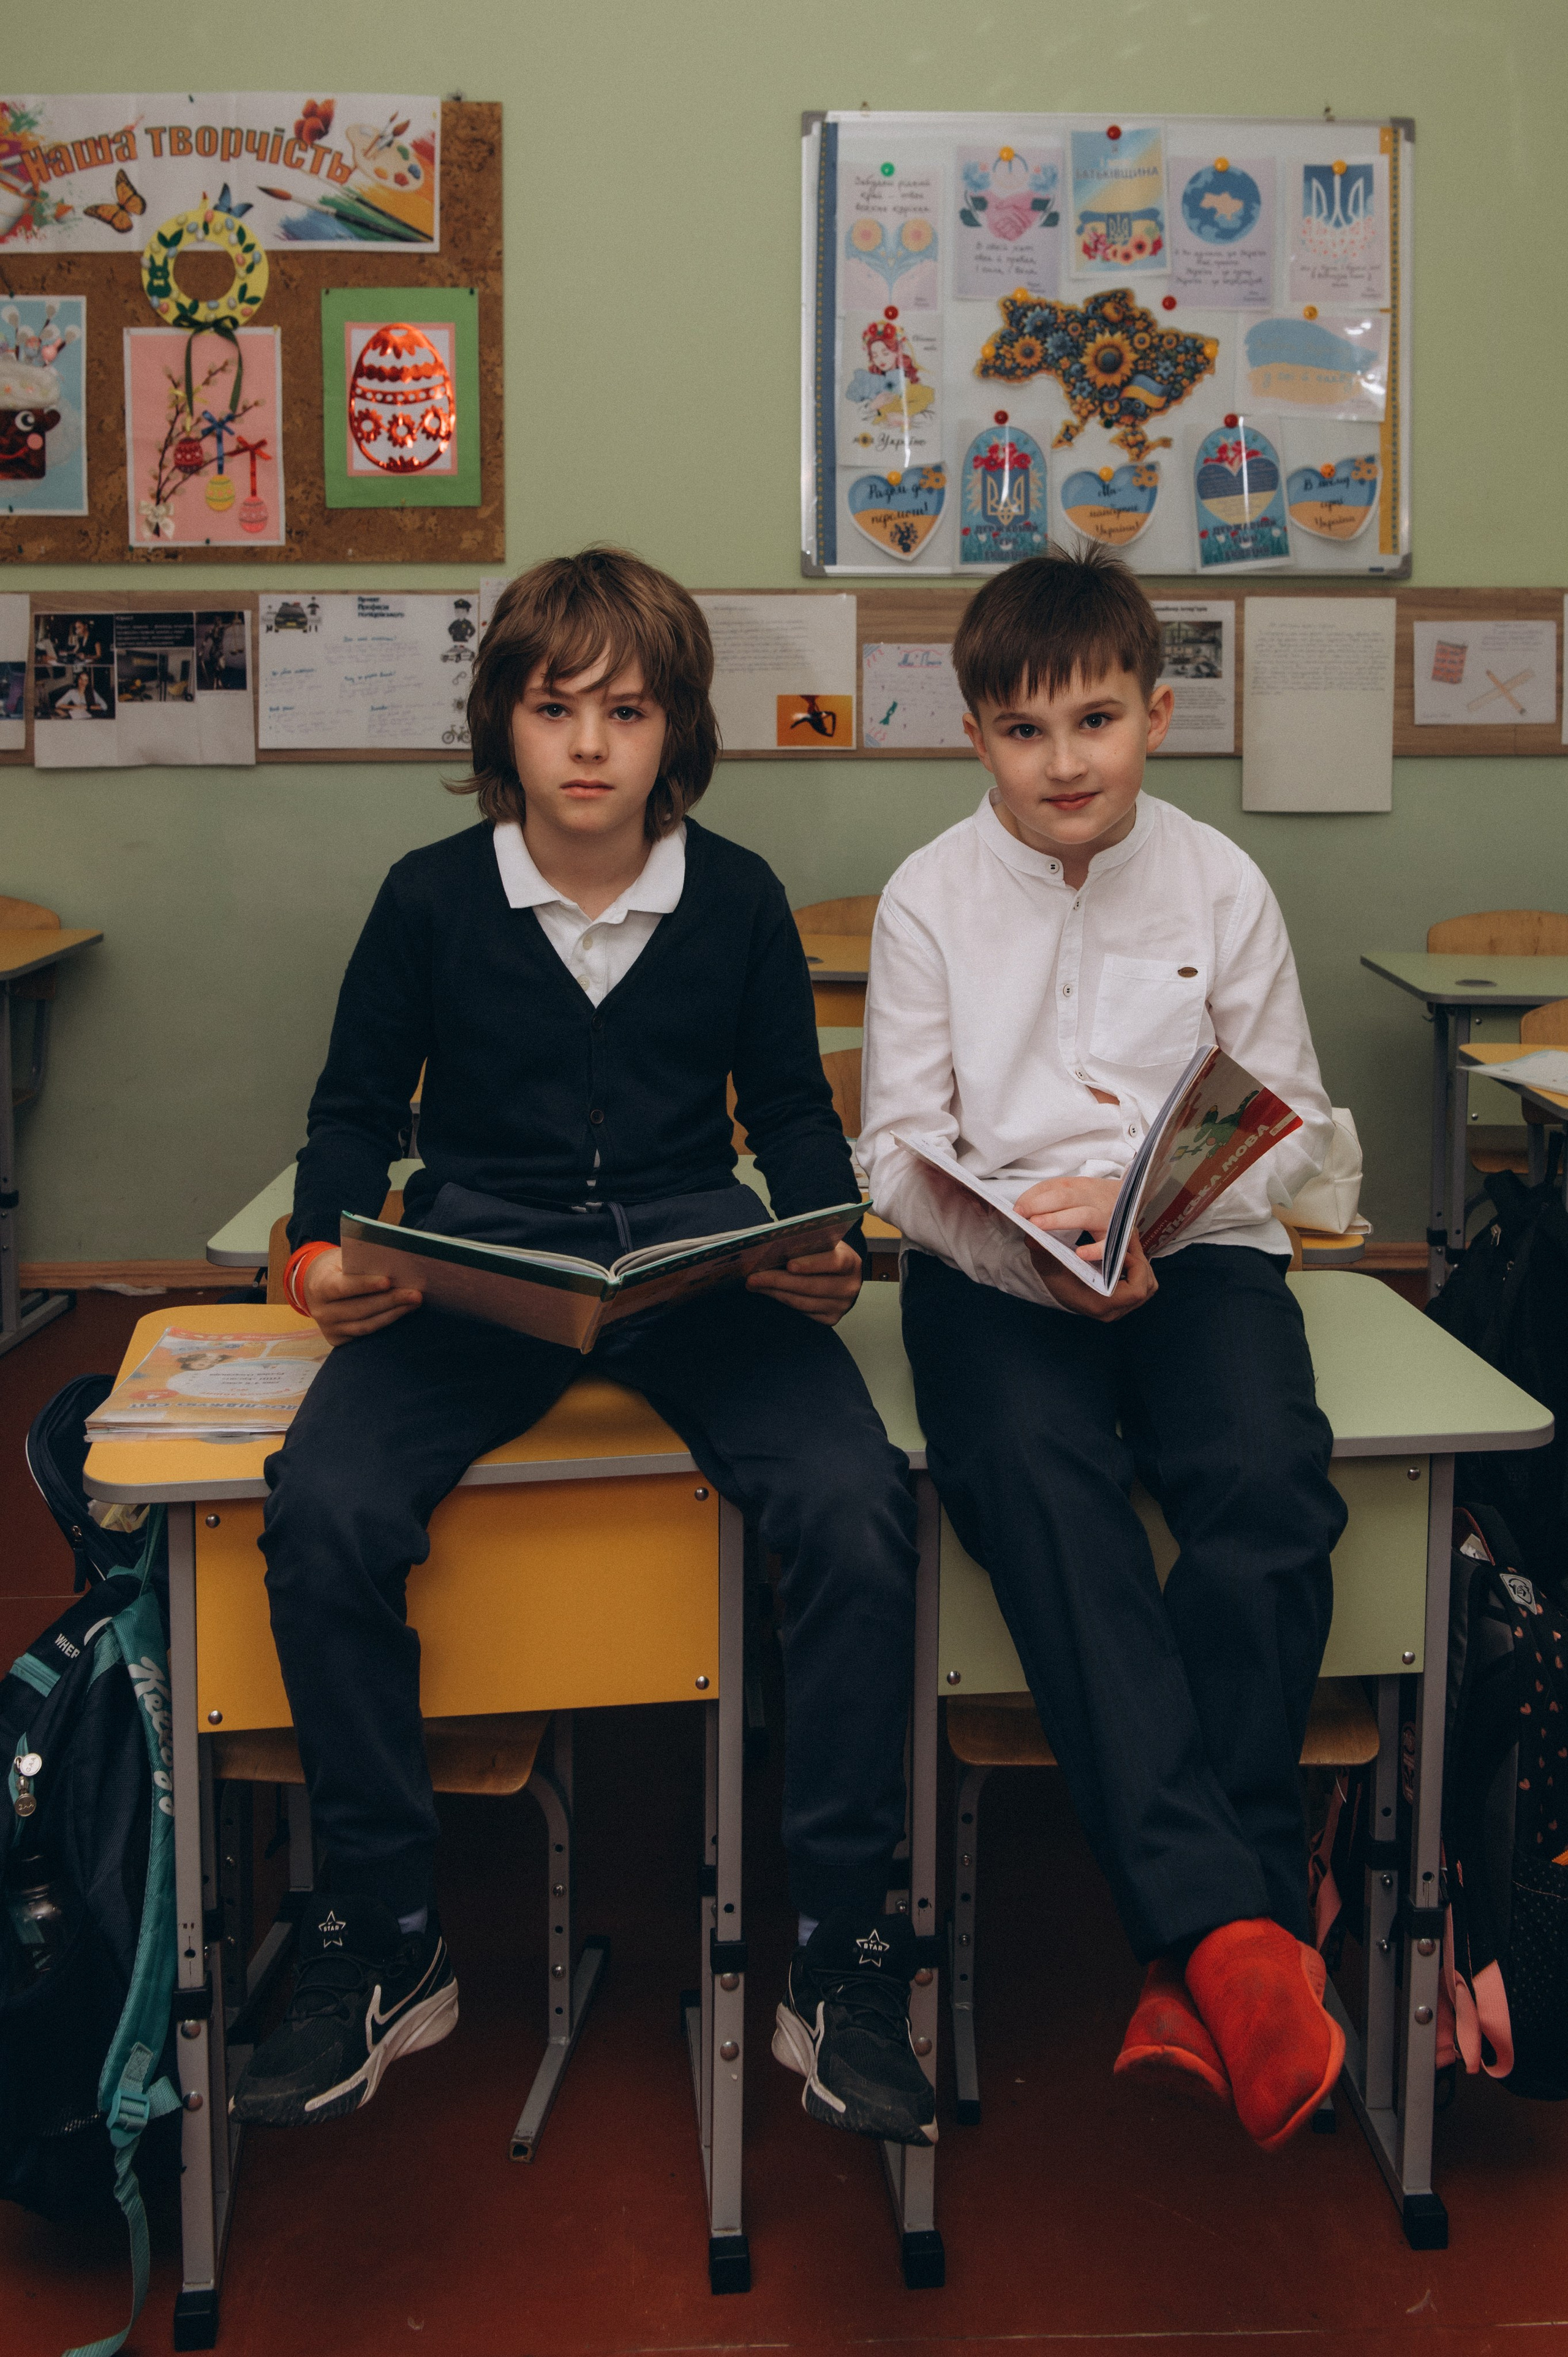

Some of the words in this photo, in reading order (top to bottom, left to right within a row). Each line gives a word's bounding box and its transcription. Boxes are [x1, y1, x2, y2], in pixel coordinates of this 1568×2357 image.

[146, 125, 353, 185] творчість
[1221, 1123, 1270, 1172] МОВА
[54, 1632, 81, 1659] WHER
[863, 1942, 883, 1952] STAR
